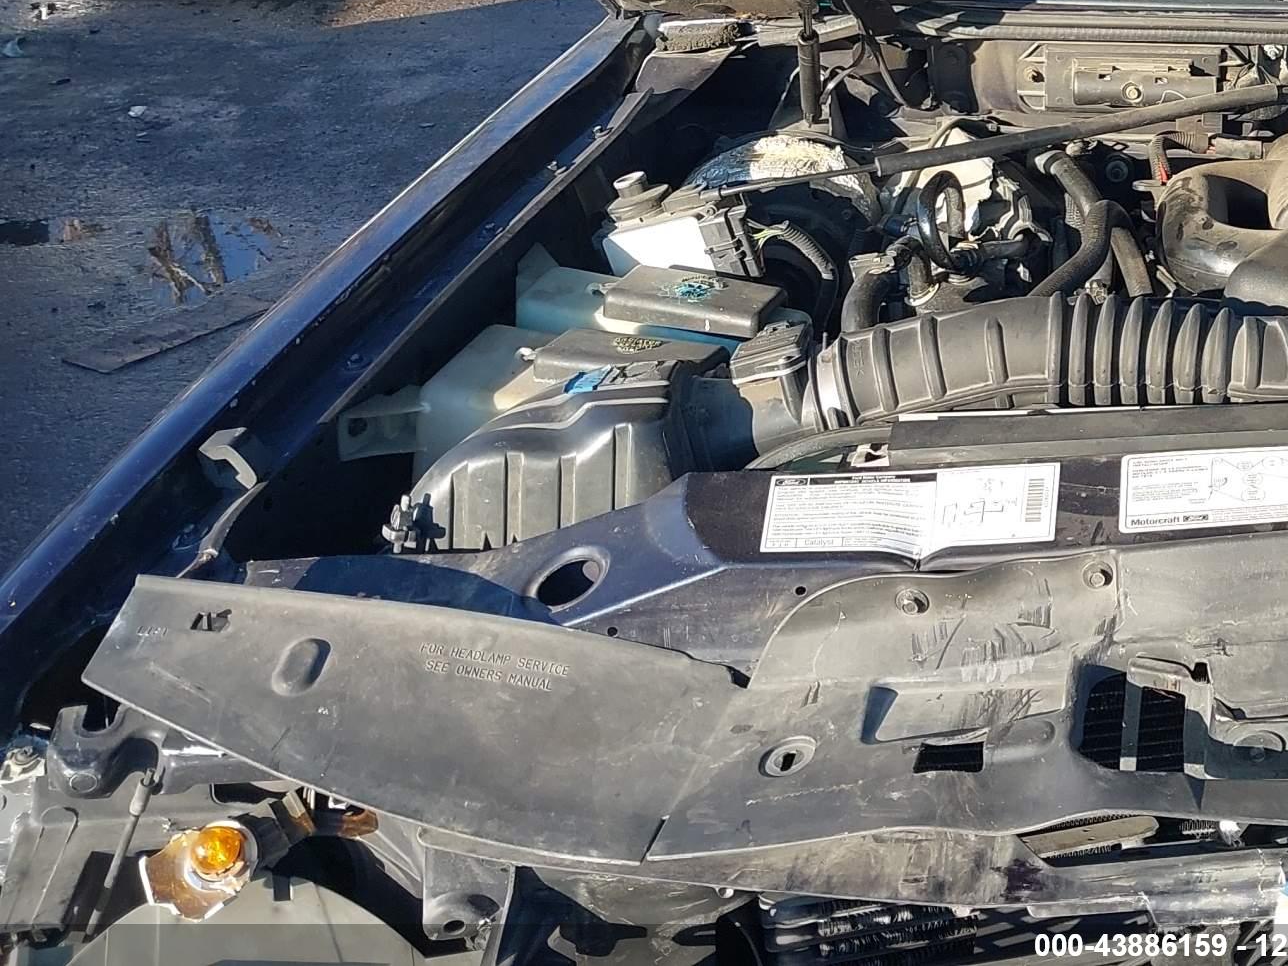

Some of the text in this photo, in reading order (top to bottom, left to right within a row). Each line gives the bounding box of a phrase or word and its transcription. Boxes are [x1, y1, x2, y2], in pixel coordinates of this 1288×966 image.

[1130, 515, 1181, 526] Motorcraft
[805, 538, 834, 547] Catalyst
[419, 642, 570, 677] FOR HEADLAMP SERVICE
[425, 659, 552, 691] SEE OWNERS MANUAL
